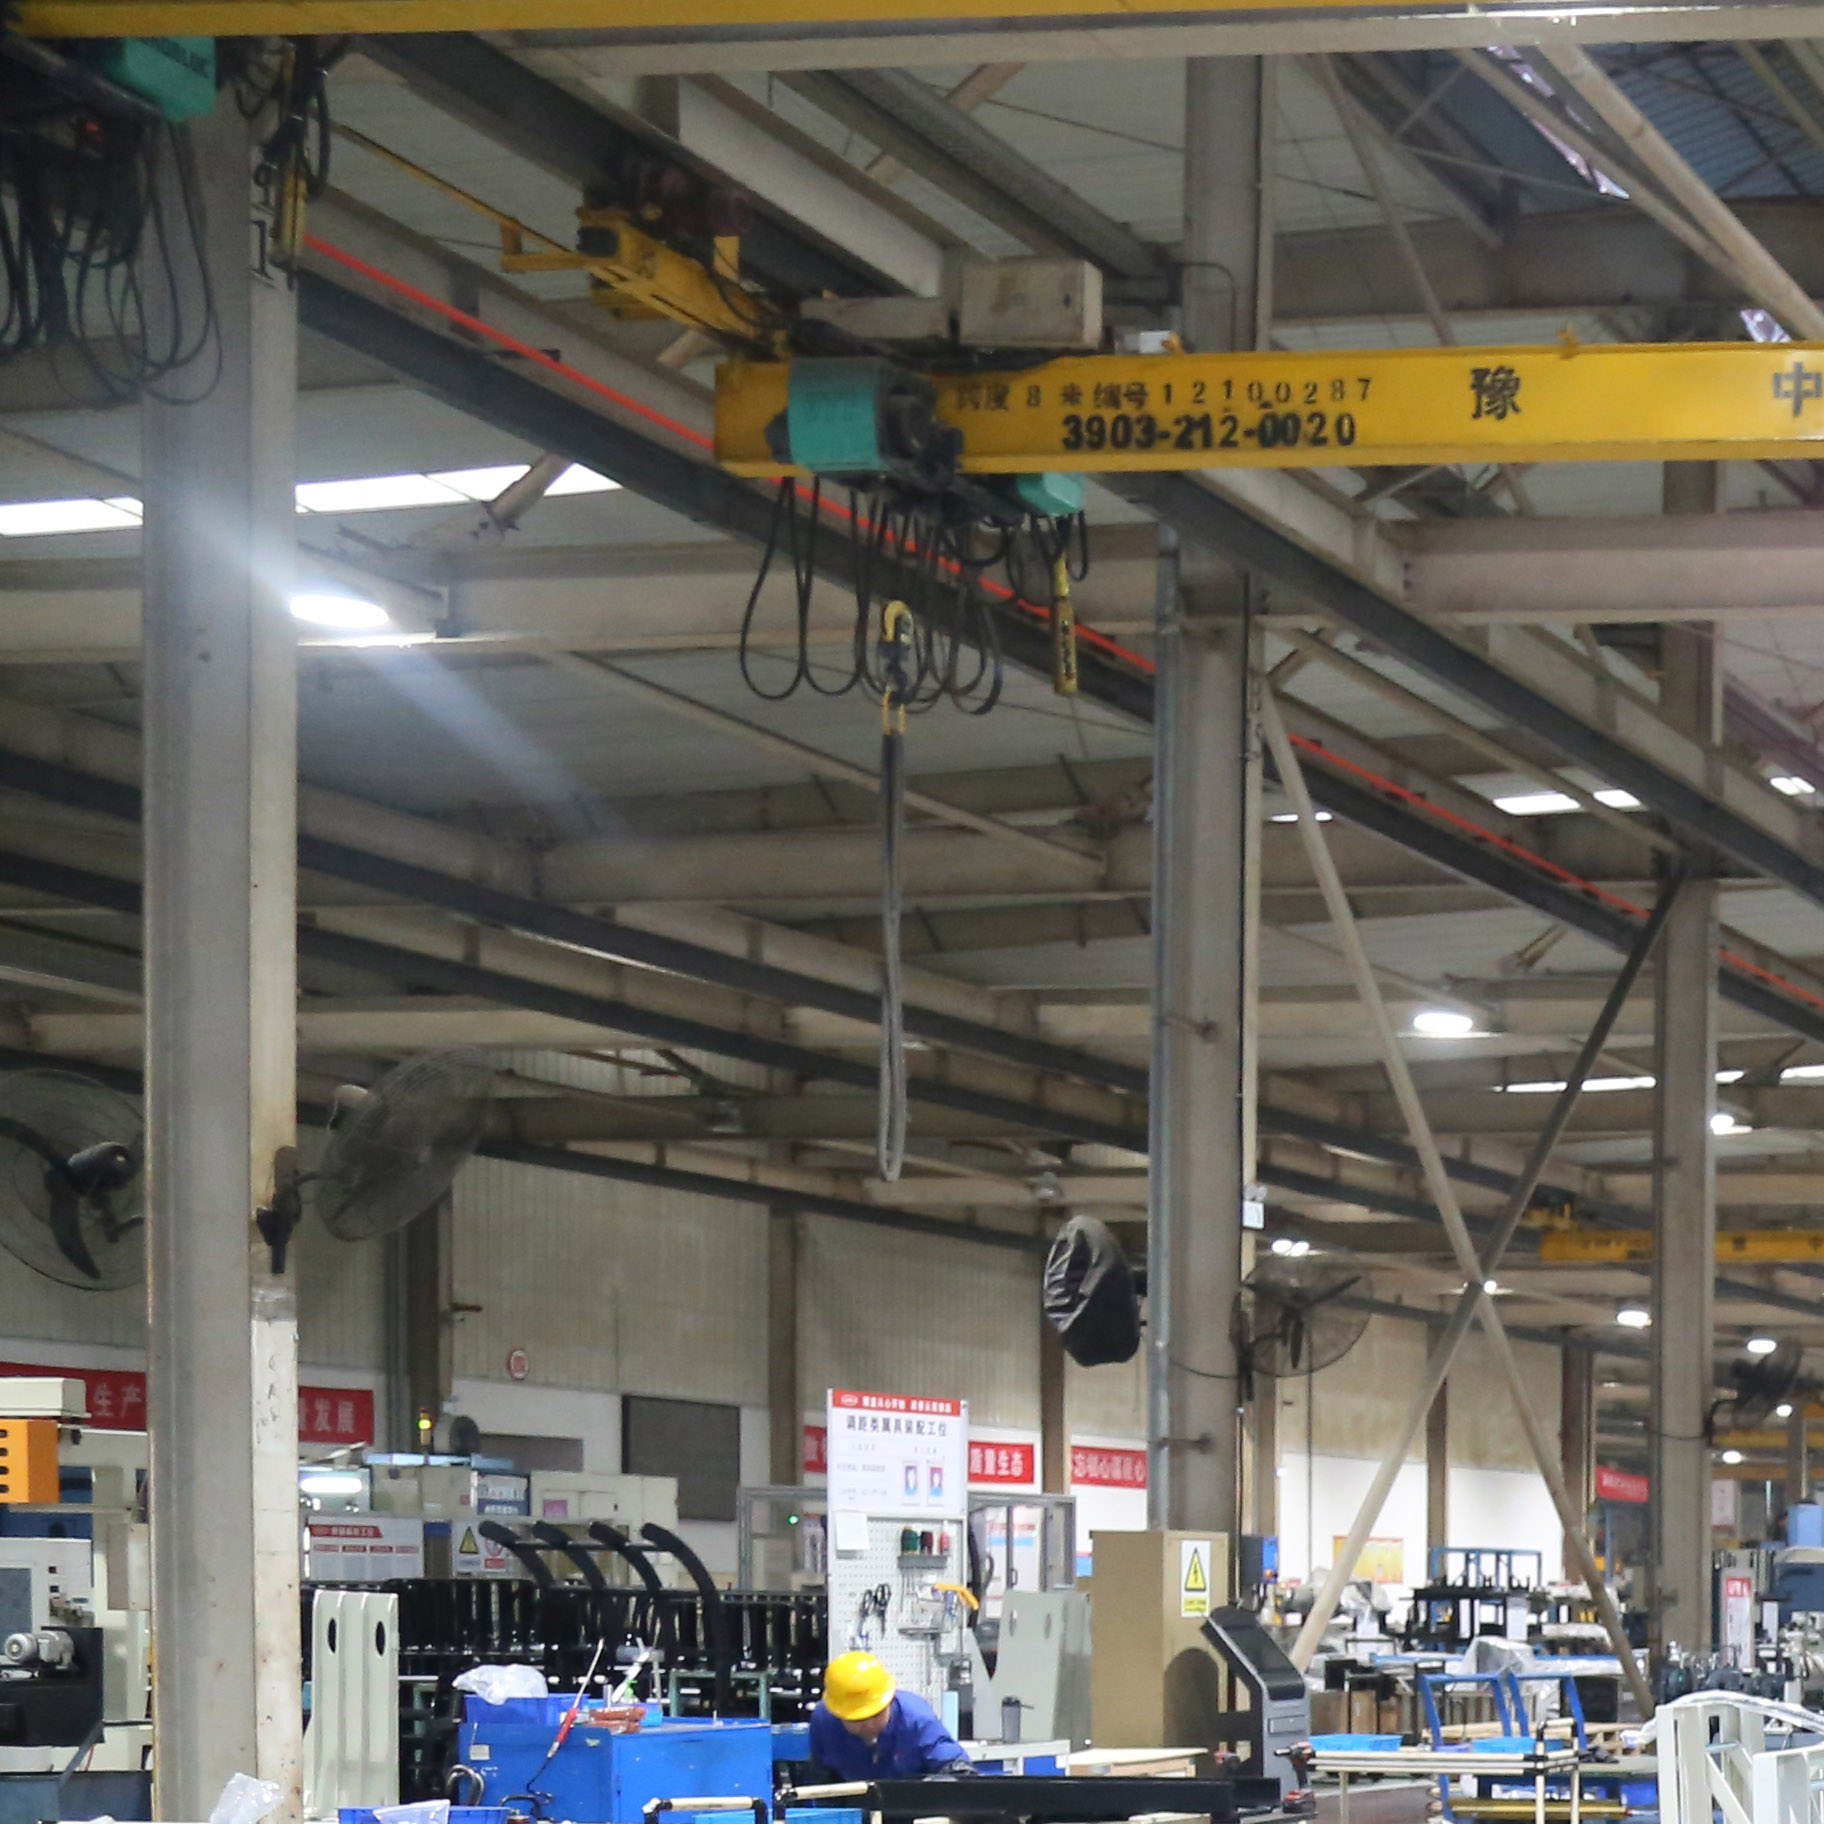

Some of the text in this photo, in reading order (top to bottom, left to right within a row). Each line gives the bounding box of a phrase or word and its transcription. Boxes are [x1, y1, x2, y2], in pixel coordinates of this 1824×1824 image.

[1471, 365, 1523, 420] 豫
[1771, 361, 1824, 418] 中
[1061, 411, 1357, 450] 3903-212-0020
[93, 1382, 143, 1420] 生产
